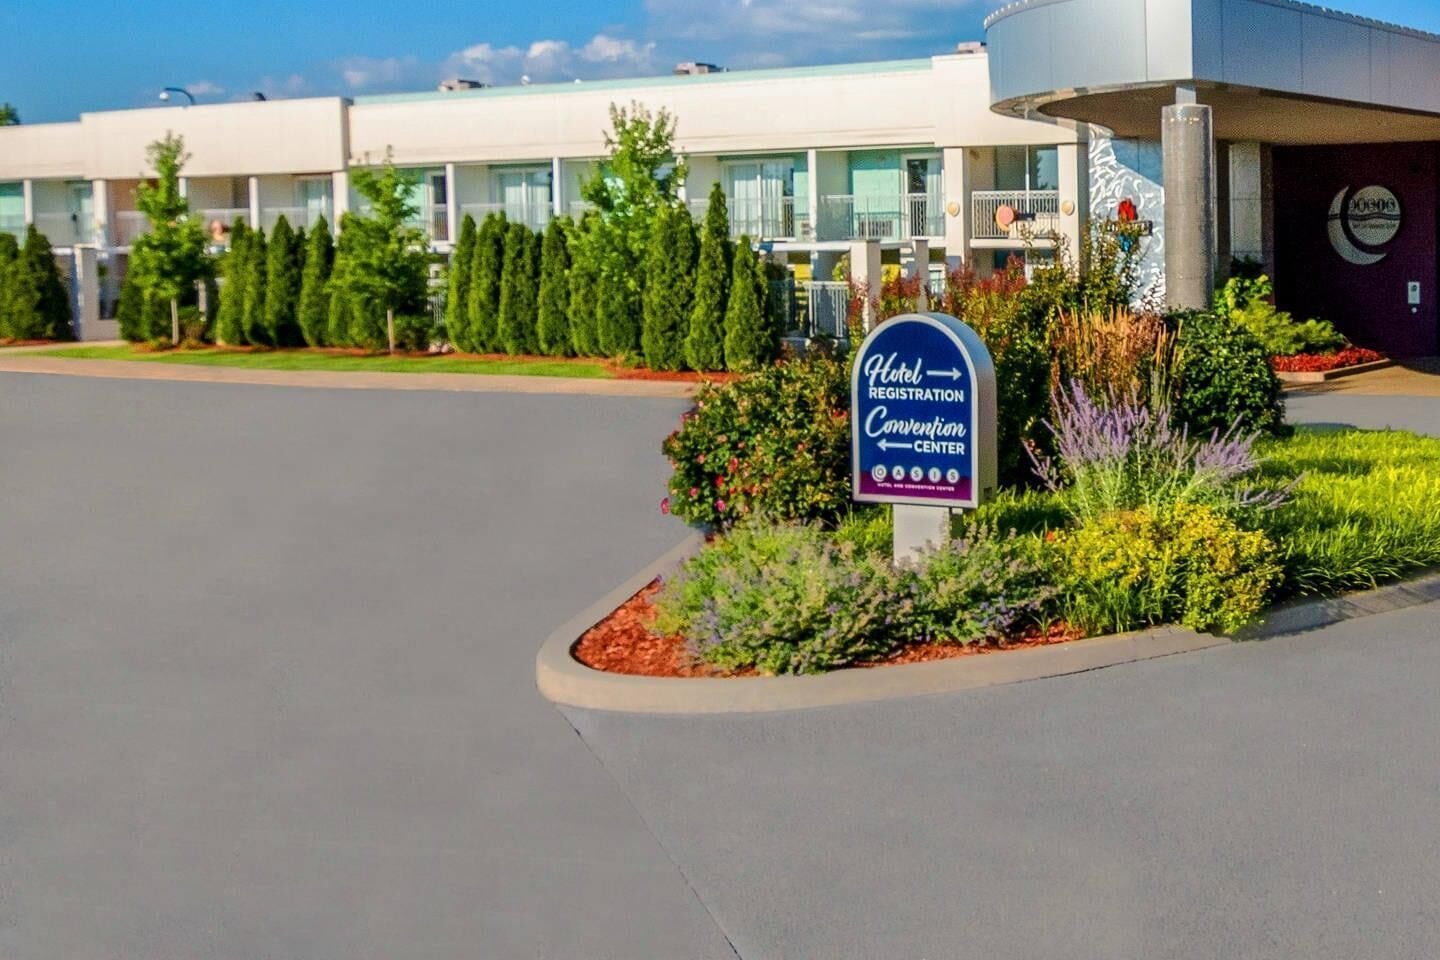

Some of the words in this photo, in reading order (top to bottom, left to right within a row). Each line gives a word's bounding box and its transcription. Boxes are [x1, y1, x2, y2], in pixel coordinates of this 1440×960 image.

[864, 352, 922, 386] Hotel
[869, 387, 964, 402] REGISTRATION
[865, 406, 966, 440] Convention
[914, 441, 965, 455] CENTER
